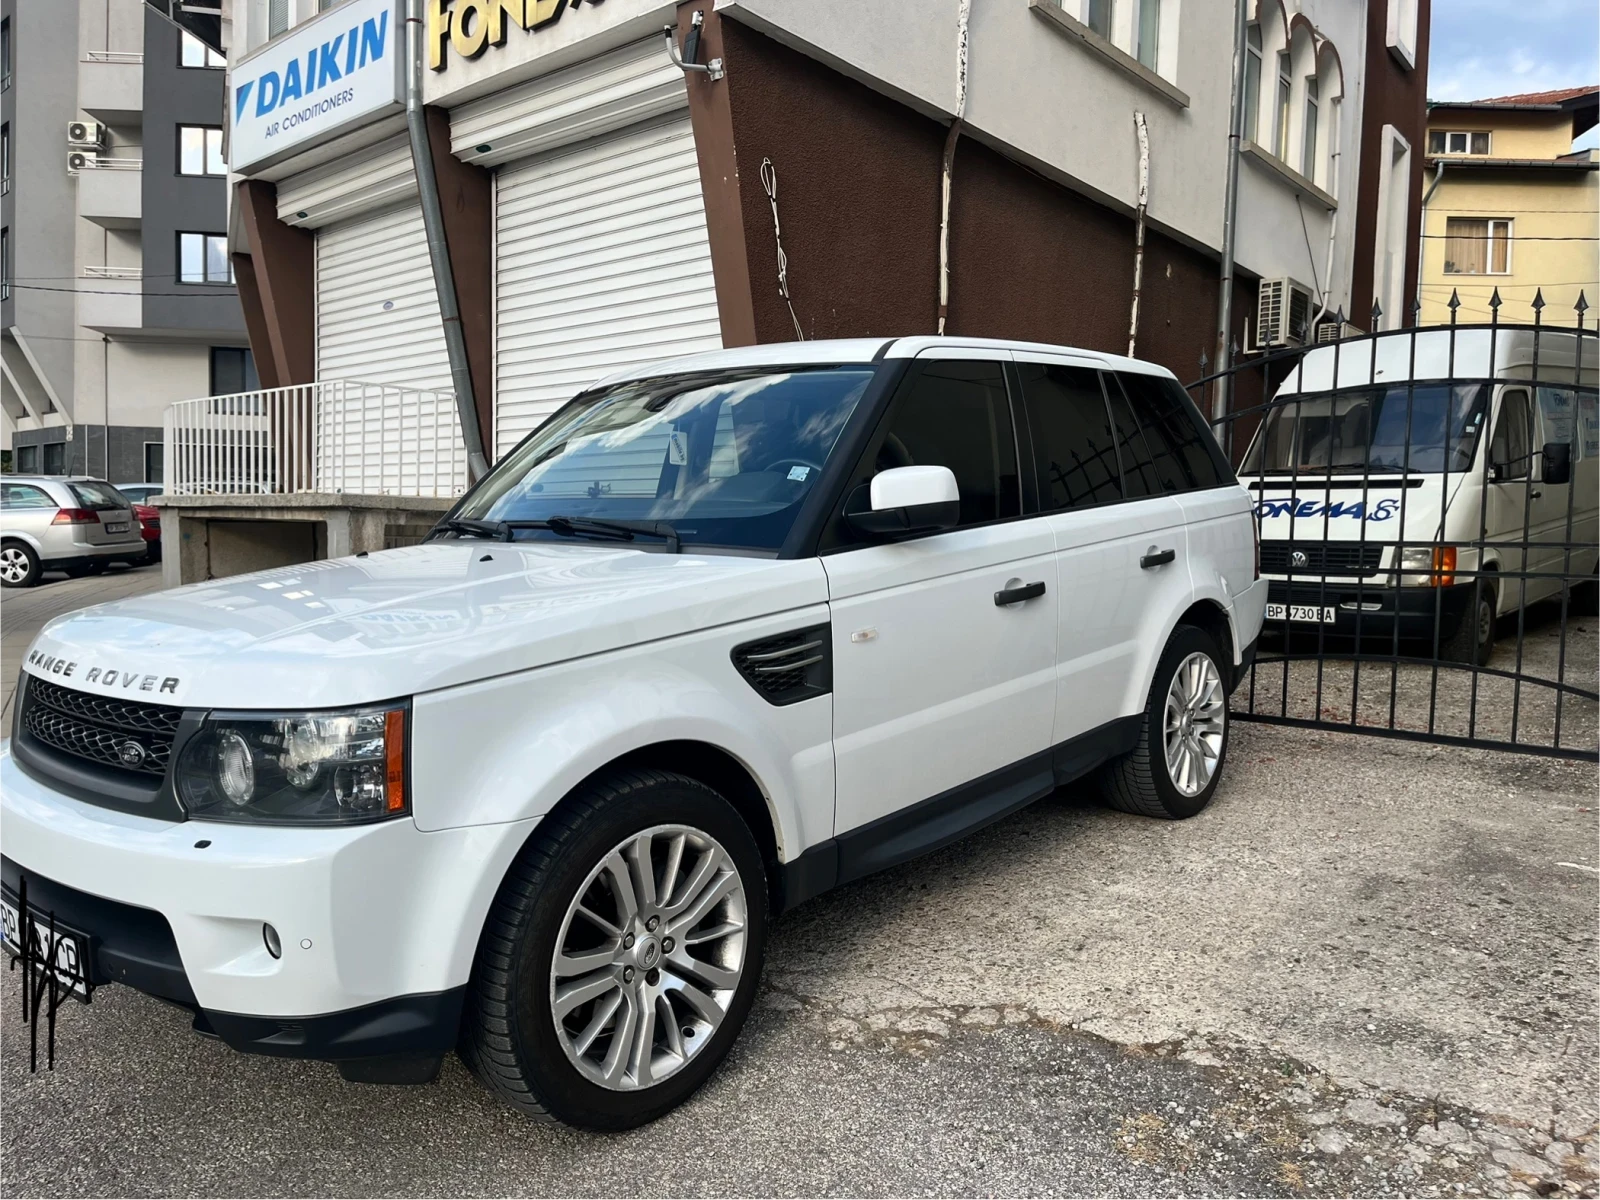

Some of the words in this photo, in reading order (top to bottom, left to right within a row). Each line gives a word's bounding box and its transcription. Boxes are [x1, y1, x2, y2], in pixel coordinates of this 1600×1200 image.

[255, 9, 389, 119] DAIKIN
[264, 122, 280, 140] AIR
[282, 87, 354, 131] CONDITIONERS
[1267, 605, 1283, 618] BP
[1285, 606, 1314, 620] 730
[28, 649, 78, 677] RANGE
[85, 667, 181, 694] ROVER
